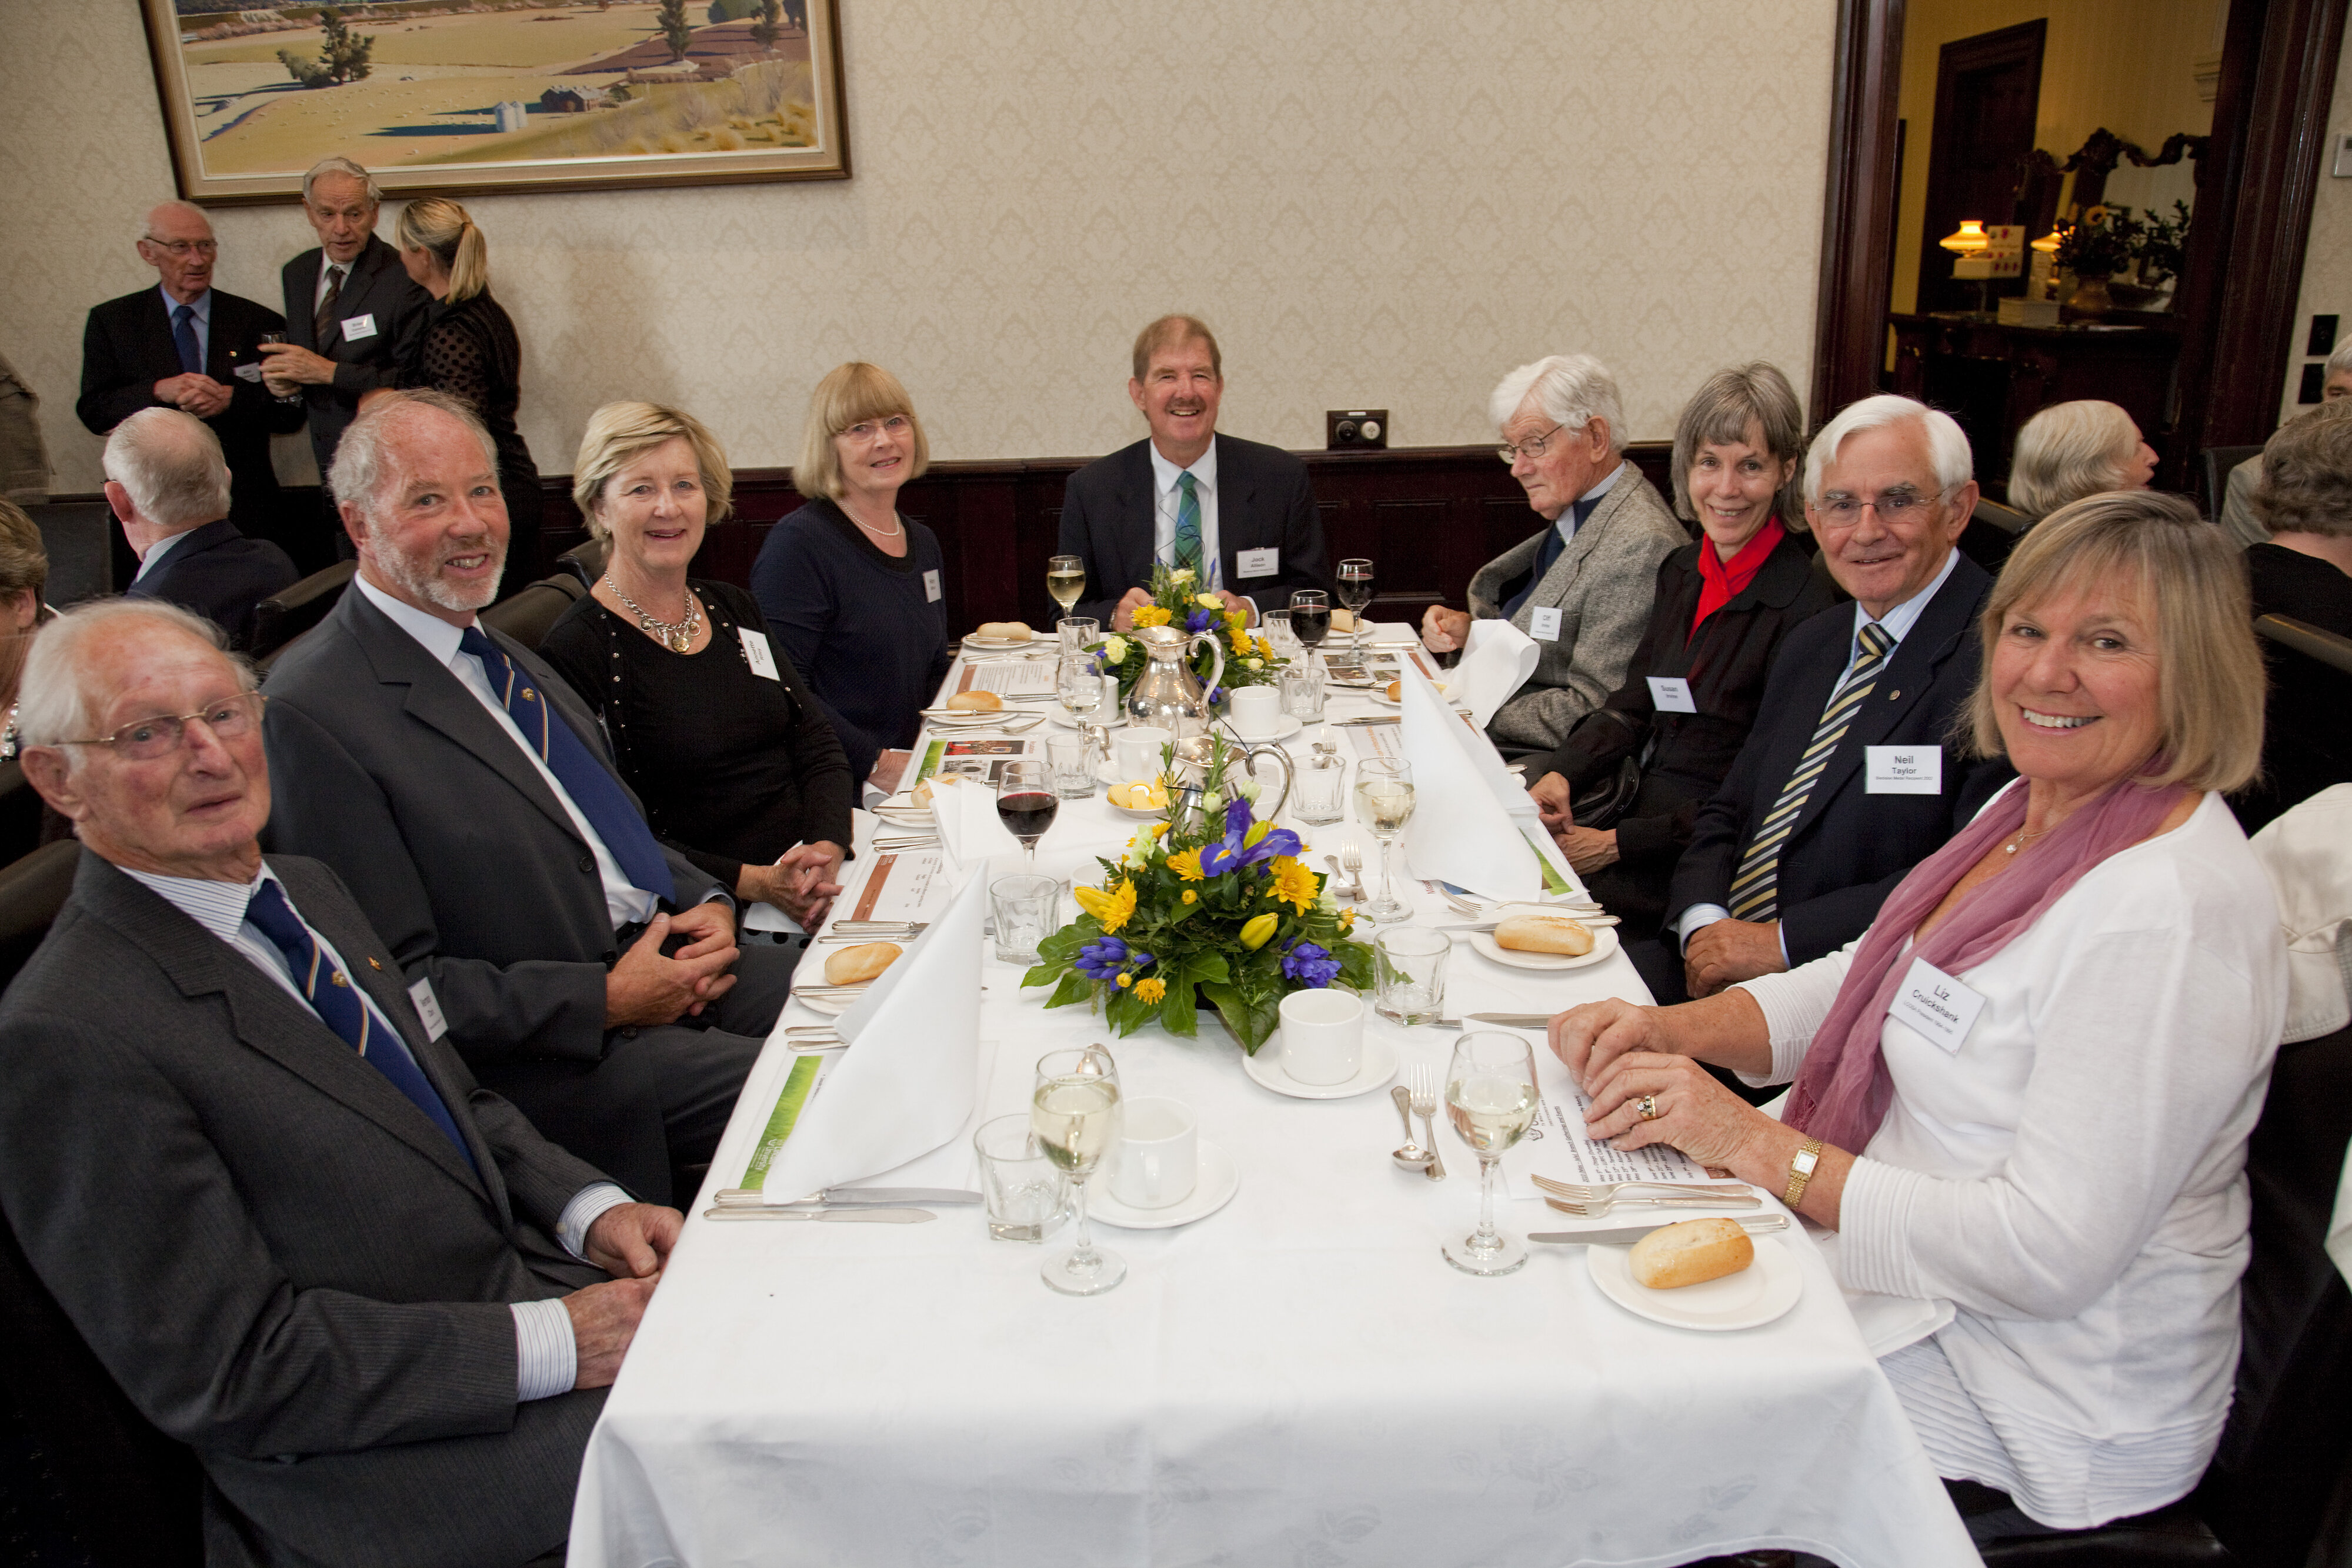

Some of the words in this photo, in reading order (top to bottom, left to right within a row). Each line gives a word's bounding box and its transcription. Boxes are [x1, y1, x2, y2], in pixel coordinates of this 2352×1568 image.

[1894, 755, 1914, 764] Neil
[1891, 767, 1917, 775] Taylor
[1934, 985, 1950, 1001] Liz
[1913, 989, 1960, 1024] Cruickshank
[1561, 1123, 1573, 1141] Gatherings
